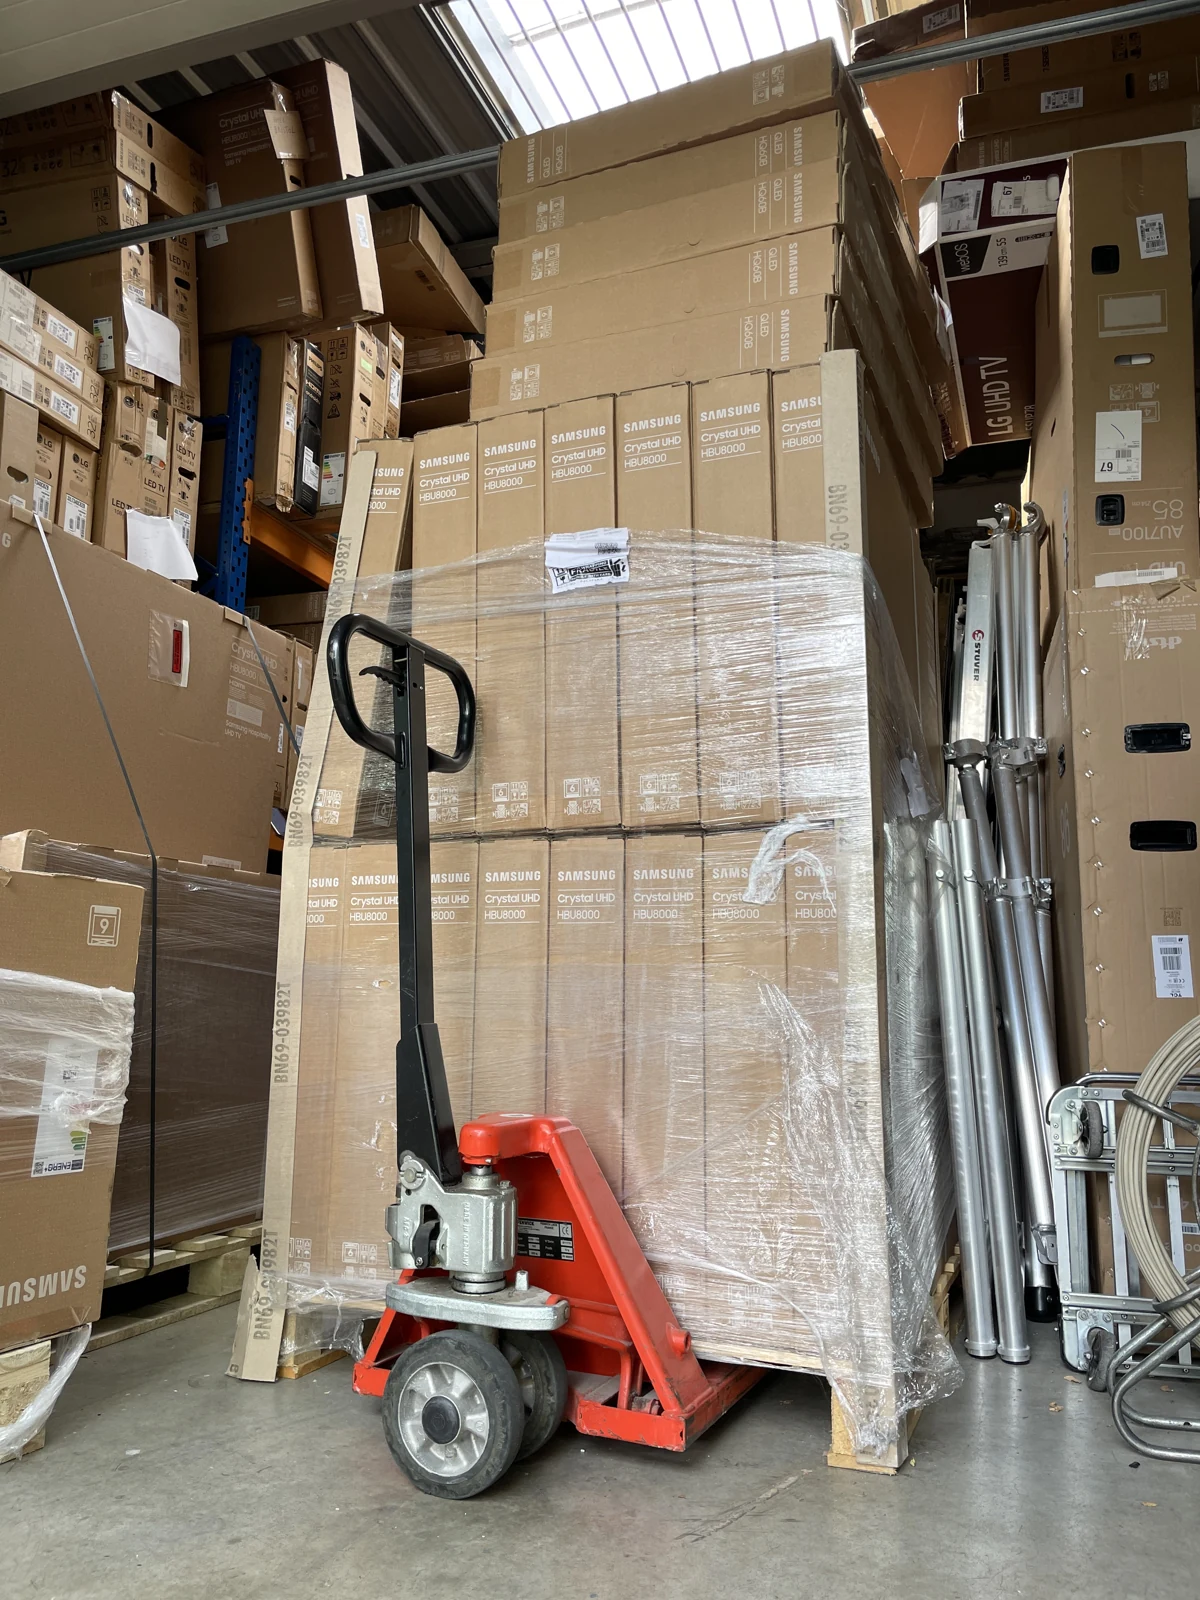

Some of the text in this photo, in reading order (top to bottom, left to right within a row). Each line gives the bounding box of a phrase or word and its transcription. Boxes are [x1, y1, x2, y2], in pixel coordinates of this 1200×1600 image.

[219, 112, 249, 129] Crystal
[774, 132, 783, 155] QLED
[526, 138, 536, 184] SAMSUNG
[543, 157, 551, 179] QLED
[555, 144, 564, 176] HQ60B
[758, 181, 767, 214] HQ60B
[774, 178, 783, 202] QLED
[793, 172, 803, 224] SAMSUNG
[1002, 185, 1013, 196] 67
[178, 235, 188, 247] LG
[169, 254, 191, 271] LED TV
[768, 247, 778, 271] QLED
[954, 243, 971, 272] webOS
[752, 250, 762, 283] HQ60B
[788, 242, 798, 295] SAMSUNG
[744, 315, 753, 350] HQ60B
[760, 313, 769, 338] QLED
[780, 309, 790, 362] SAMSUNG
[978, 356, 1013, 436] LG UHD TV
[700, 402, 761, 422] SAMSUNG
[87, 420, 96, 440] 32
[623, 414, 682, 433] SAMSUNG
[782, 418, 821, 434] Crystal
[551, 426, 606, 445] SAMSUNG
[701, 424, 761, 444] Crystal UHD
[782, 434, 822, 449] HBU800
[43, 438, 53, 449] LG
[484, 439, 536, 457] SAMSUNG
[624, 435, 682, 454] Crystal UHD
[701, 443, 746, 459] HBU8000
[176, 444, 197, 461] LED TV
[419, 452, 470, 469] SAMSUNG
[552, 446, 606, 465] Crystal UHD
[624, 453, 667, 469] HBU8000
[79, 456, 89, 468] LG
[484, 459, 536, 476] Crystal UHD
[1100, 461, 1113, 472] 67
[419, 472, 470, 488] Crystal UHD
[551, 464, 592, 479] HBU8000
[144, 477, 166, 494] LED TV
[384, 487, 401, 496] UHD
[484, 477, 523, 491] HBU8000
[419, 488, 457, 502] HBU8000
[112, 498, 126, 510] LED
[1152, 499, 1184, 520] 85
[1122, 525, 1184, 541] AU7100
[231, 642, 259, 664] Crysta
[972, 641, 982, 682] STUVER
[229, 662, 257, 680] HBU8000
[288, 753, 314, 848] BN69-03982T
[351, 873, 397, 887] SAMSUN
[431, 872, 470, 883] MSUNG
[485, 870, 541, 882] SAMSUNG
[557, 869, 616, 881] SAMSUNG
[633, 868, 694, 880] SAMSUNG
[712, 867, 749, 879] SAMS
[309, 877, 339, 888] SUNG
[321, 898, 338, 908] UHD
[350, 895, 383, 908] Crystal
[451, 894, 470, 904] UHD
[484, 893, 541, 905] Crystal UHD
[557, 891, 615, 904] Crystal UHD
[633, 891, 694, 903] Crystal UHD
[350, 911, 388, 922] HBU8000
[432, 910, 455, 921] 8000
[484, 909, 526, 920] HBU8000
[557, 909, 600, 920] HBU8000
[633, 908, 678, 920] HBU8000
[712, 908, 760, 920] HBU8000
[795, 908, 837, 920] HBU800
[99, 917, 111, 934] 9
[272, 982, 291, 1084] BN69-03982T
[0, 1266, 87, 1310] SAMSU
